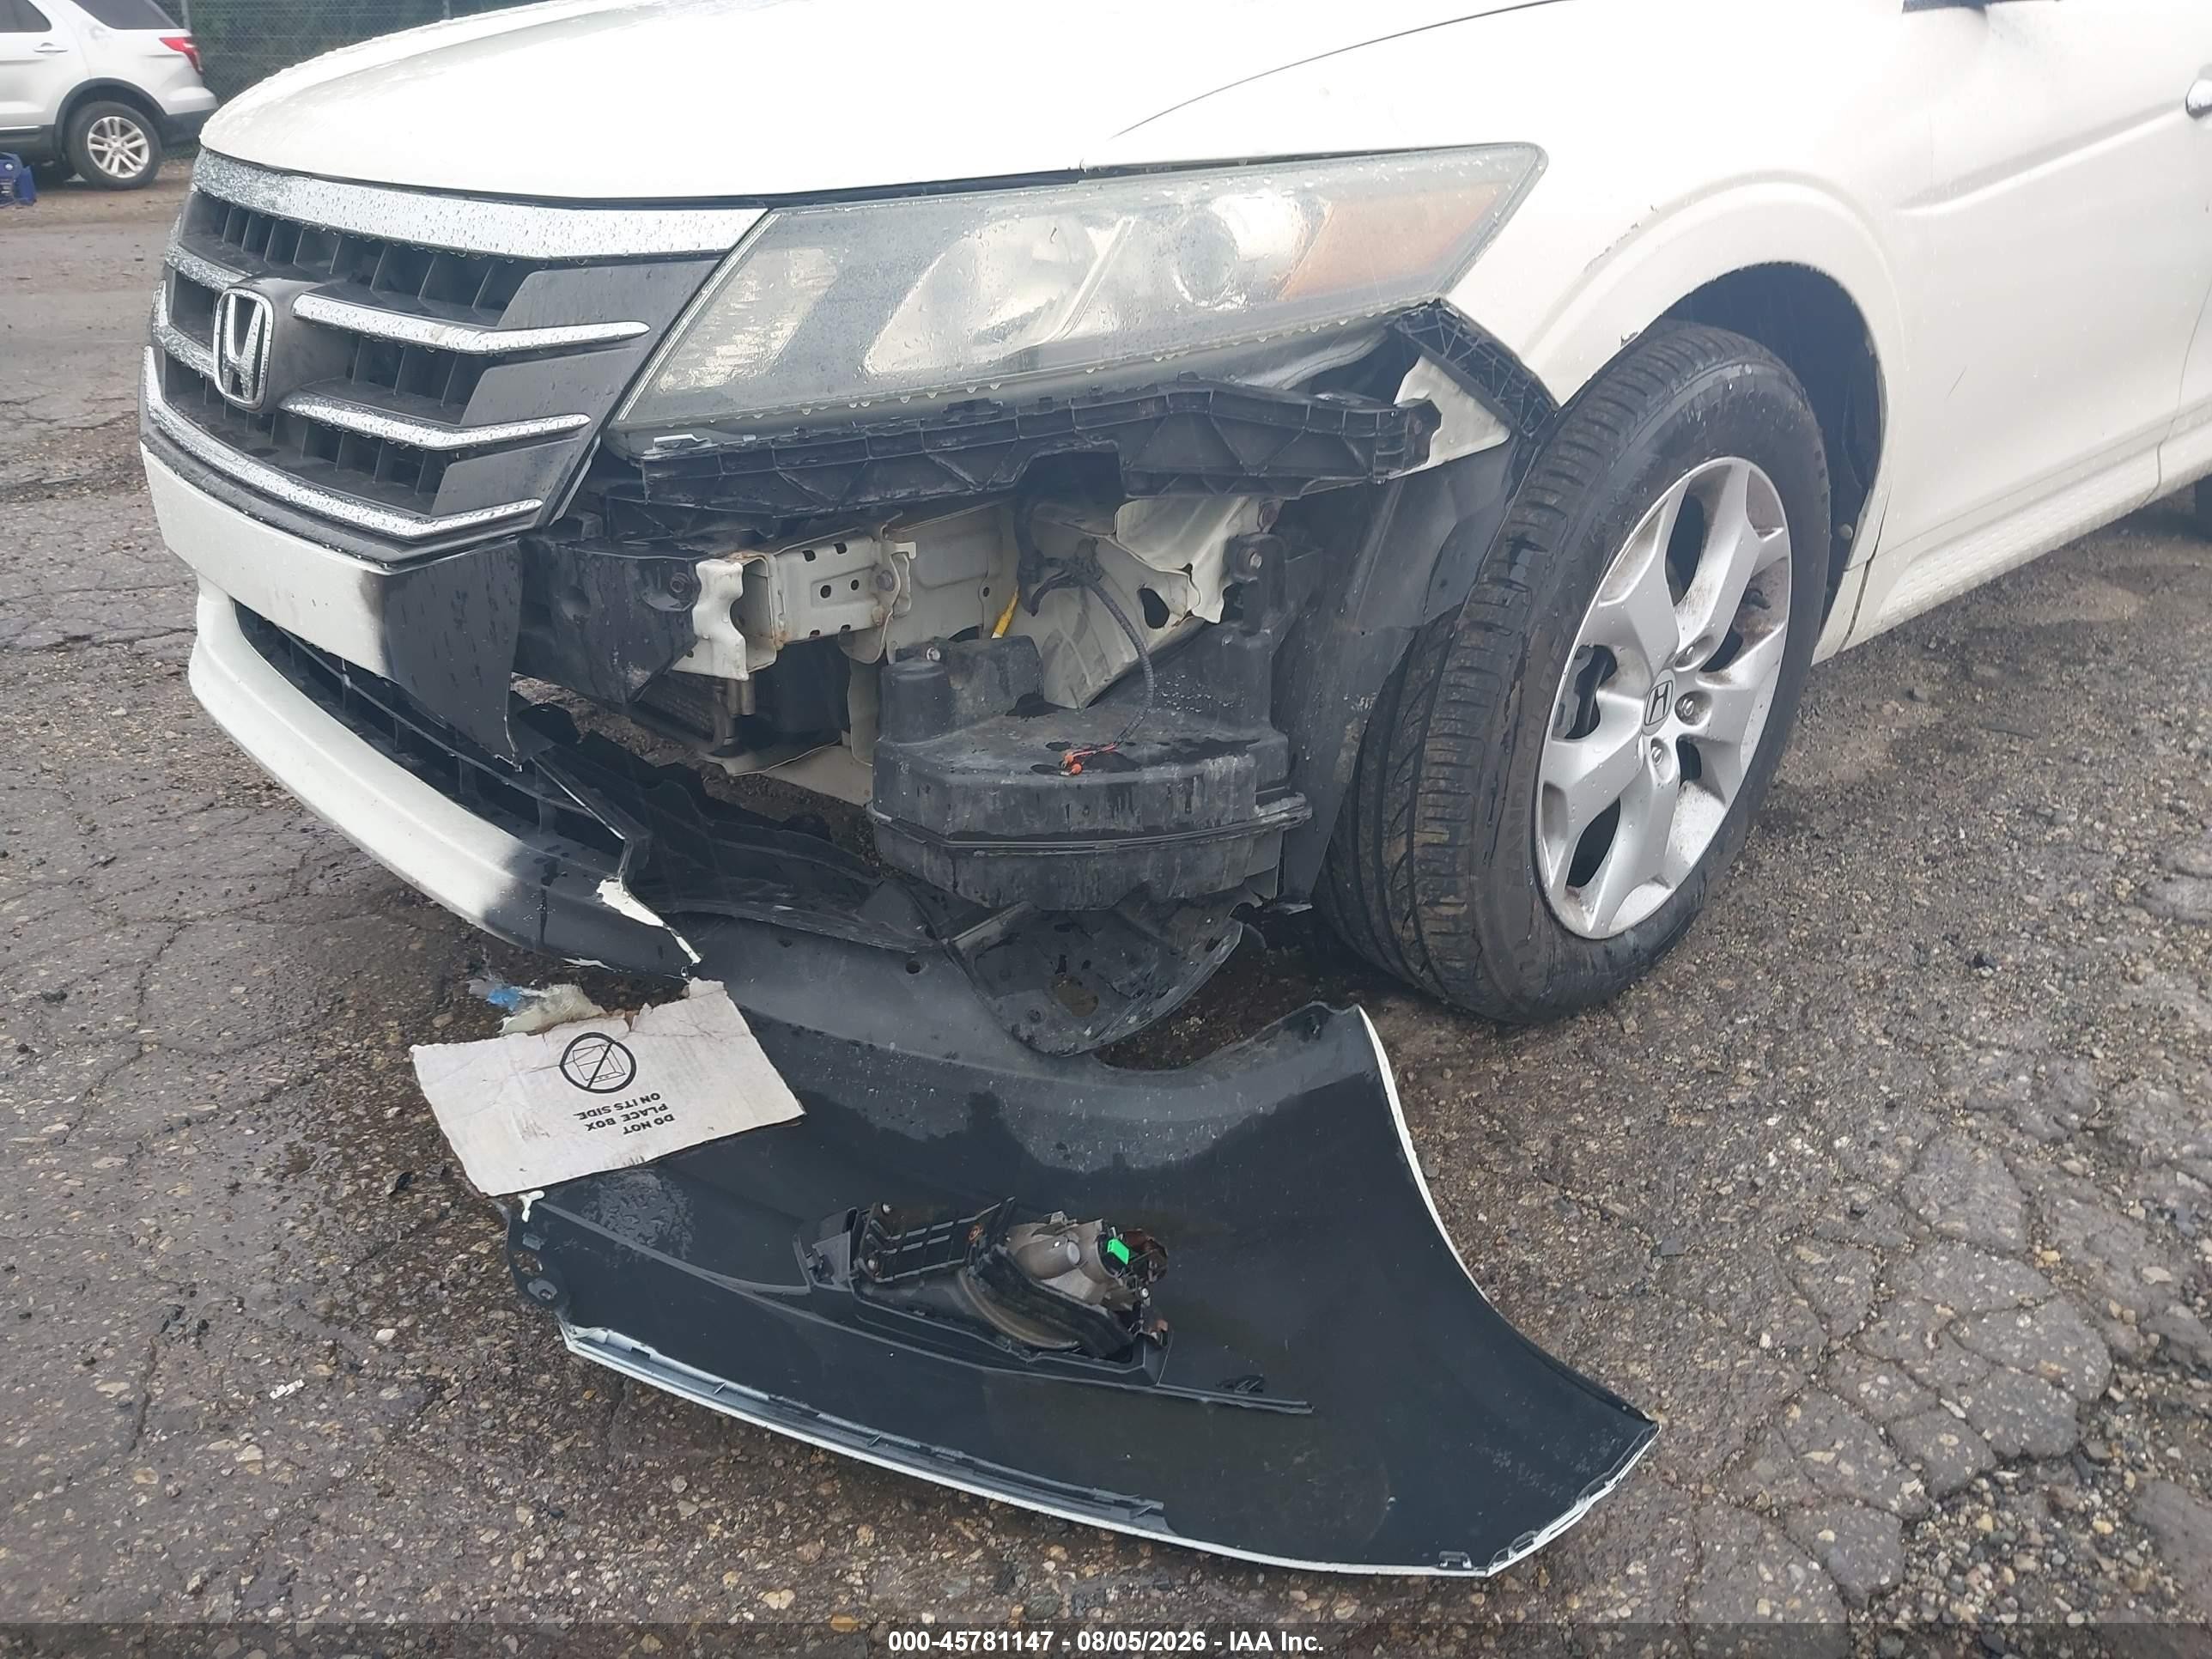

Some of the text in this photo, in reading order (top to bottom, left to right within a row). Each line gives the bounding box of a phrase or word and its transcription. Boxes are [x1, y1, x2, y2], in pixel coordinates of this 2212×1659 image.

[613, 1098, 638, 1110] ITS
[639, 1092, 660, 1103] ON
[584, 1103, 668, 1131] PLACE BOX
[623, 1114, 675, 1134] DO NOT
